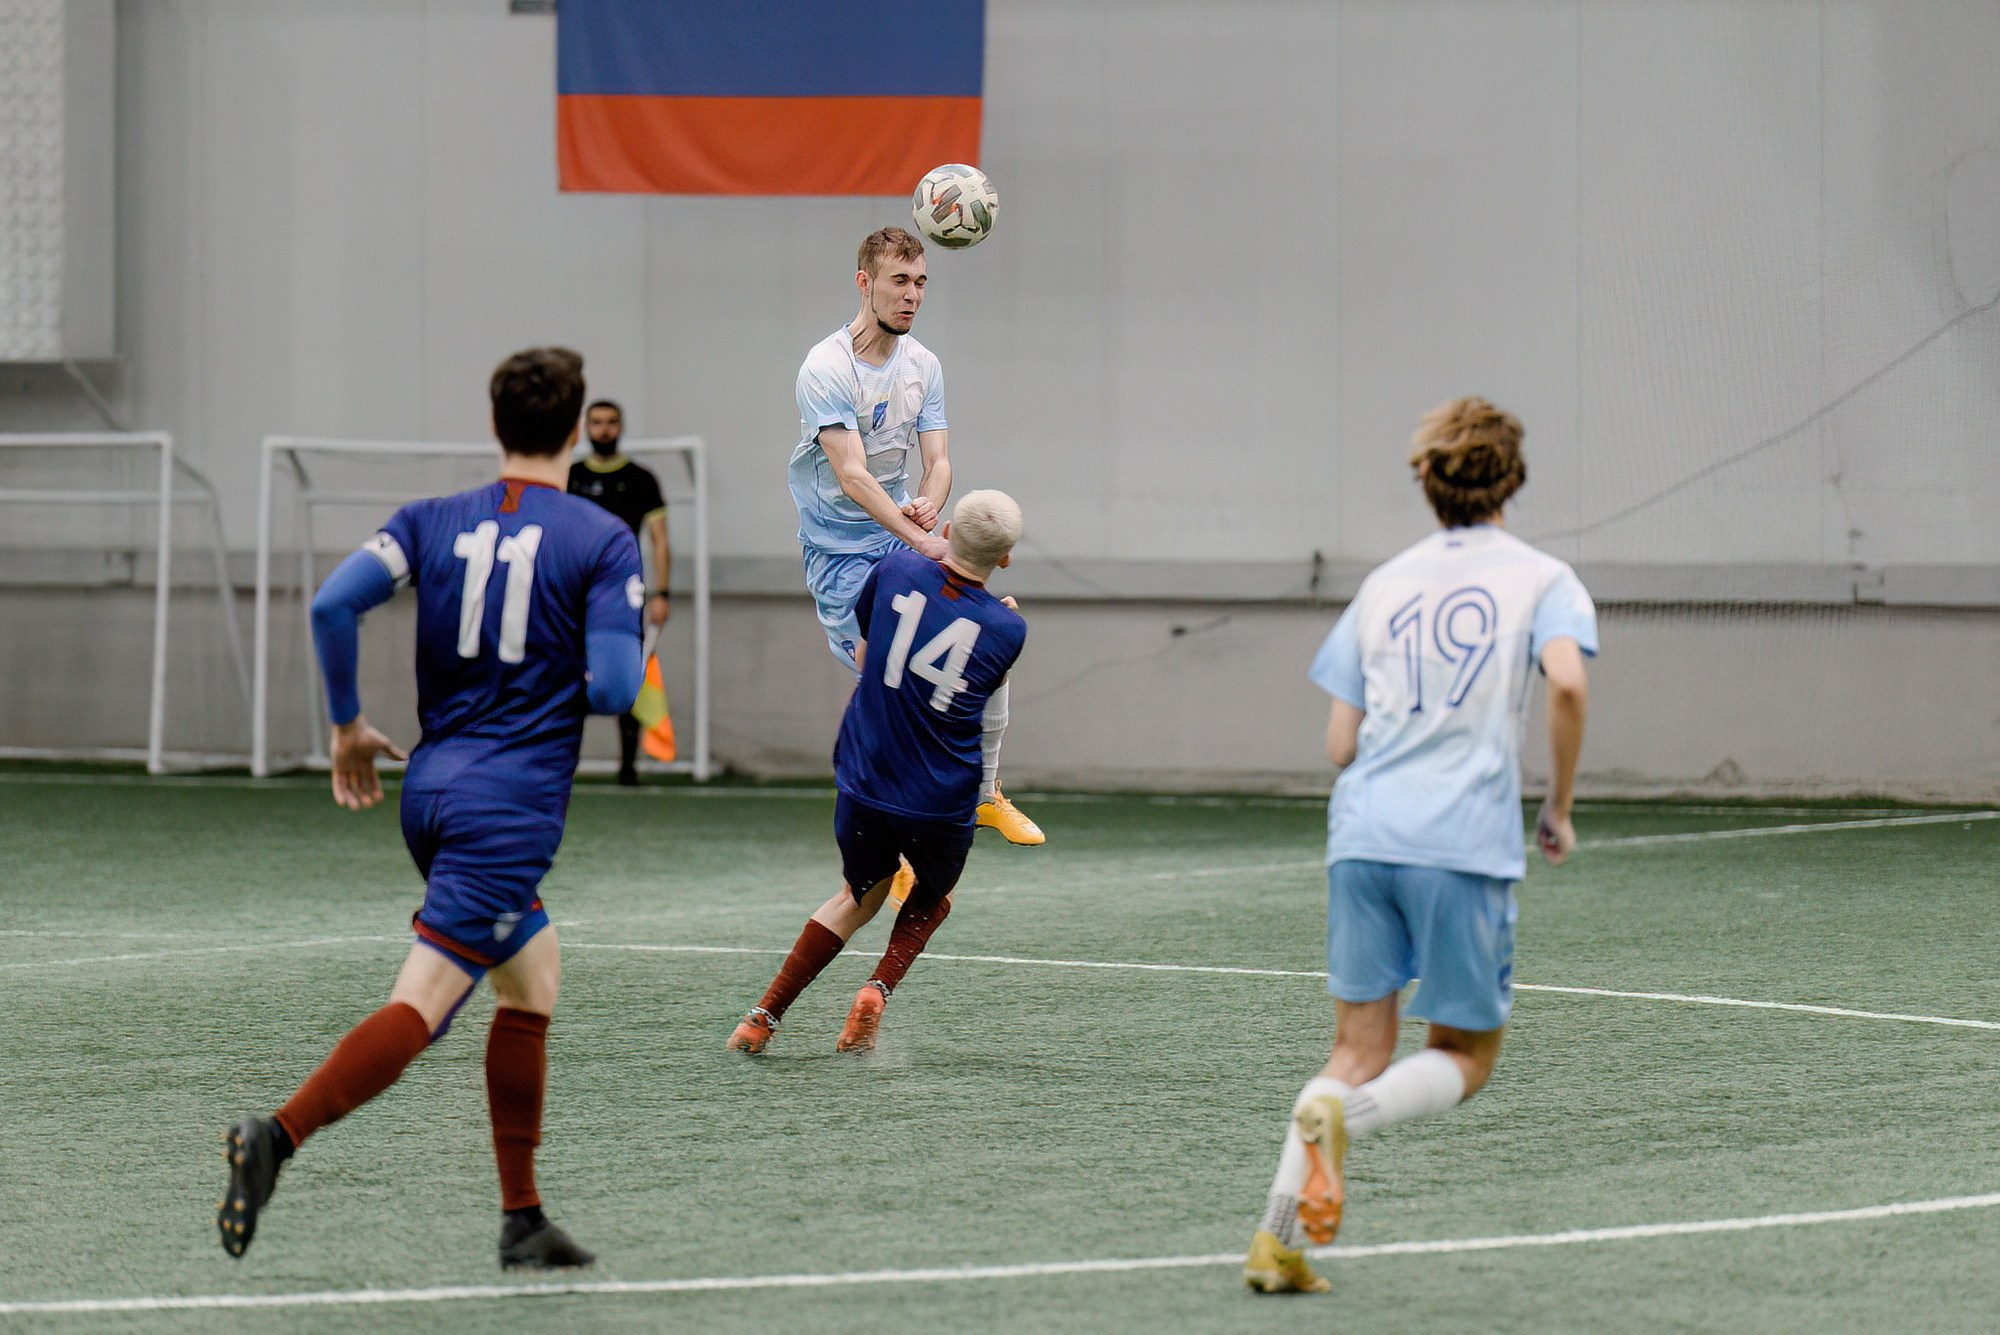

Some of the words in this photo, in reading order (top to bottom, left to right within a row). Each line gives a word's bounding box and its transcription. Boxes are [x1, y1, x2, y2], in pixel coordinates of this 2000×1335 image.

[454, 521, 542, 664] 11
[884, 591, 981, 712] 14
[1389, 586, 1497, 713] 19
